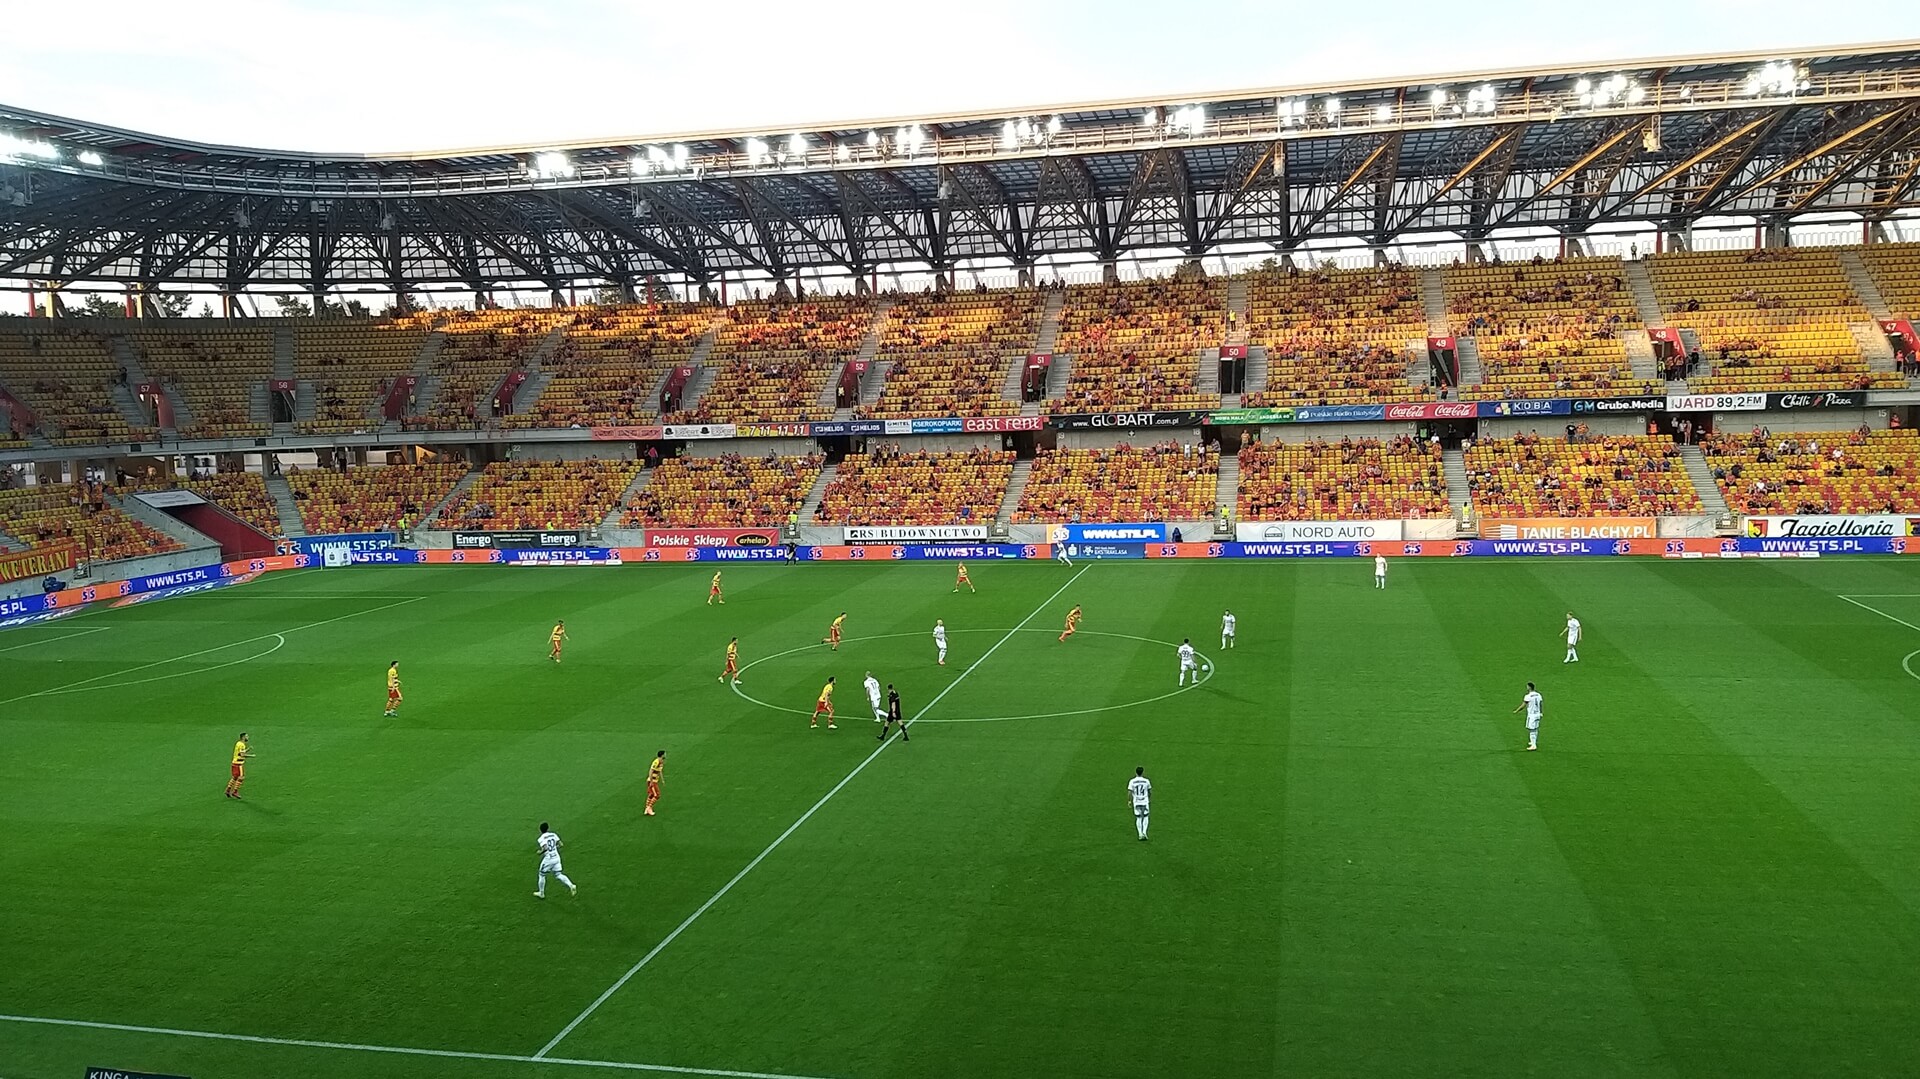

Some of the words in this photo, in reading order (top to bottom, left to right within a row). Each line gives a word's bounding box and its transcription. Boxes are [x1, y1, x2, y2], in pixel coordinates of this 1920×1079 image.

[1886, 322, 1896, 331] 47
[1656, 330, 1666, 339] 48
[1436, 340, 1446, 348] 49
[1229, 348, 1238, 356] 50
[518, 374, 526, 382] 54
[1675, 398, 1715, 409] JARD
[1716, 396, 1745, 411] 89,2
[1747, 396, 1762, 404] FM
[1780, 394, 1811, 408] Chilli
[1825, 392, 1852, 406] Pizza
[1574, 402, 1595, 411] GM
[1596, 400, 1664, 410] Grube.Media
[1878, 409, 1887, 417] 15
[859, 423, 880, 432] HELIOS
[912, 420, 962, 428] KSEROKOPIARKI
[966, 418, 1000, 431] east
[1005, 416, 1040, 430] rent
[749, 425, 756, 436] 7
[759, 425, 770, 436] 11
[777, 424, 788, 436] 11
[792, 424, 804, 436] 11
[823, 425, 844, 433] HELIOS
[867, 436, 876, 444] 20
[860, 530, 874, 539] RS
[881, 528, 981, 538] BUDOWNICTWO
[1292, 527, 1333, 537] NORD
[1338, 526, 1375, 537] AUTO
[1521, 526, 1651, 538] TANIE-BLACHY.PL
[1780, 519, 1893, 538] Jagiellonia
[1083, 529, 1159, 539] WWW.STS.PL
[456, 533, 491, 546] Energo
[541, 533, 577, 546] Energo
[653, 535, 689, 545] Polskie
[694, 535, 728, 547] Sklepy
[1244, 545, 1332, 555] WWW.STS.PL
[1494, 543, 1590, 553] WWW.STS.PL
[1762, 540, 1863, 550] WWW.STS.PL
[518, 551, 589, 560] WWW.STS.PL
[717, 549, 789, 559] WWW.STS.PL
[924, 547, 1002, 557] WWW.STS.PL
[0, 550, 70, 581] WETERANI
[146, 568, 208, 589] WWW.STS.PL
[1135, 785, 1145, 796] 14
